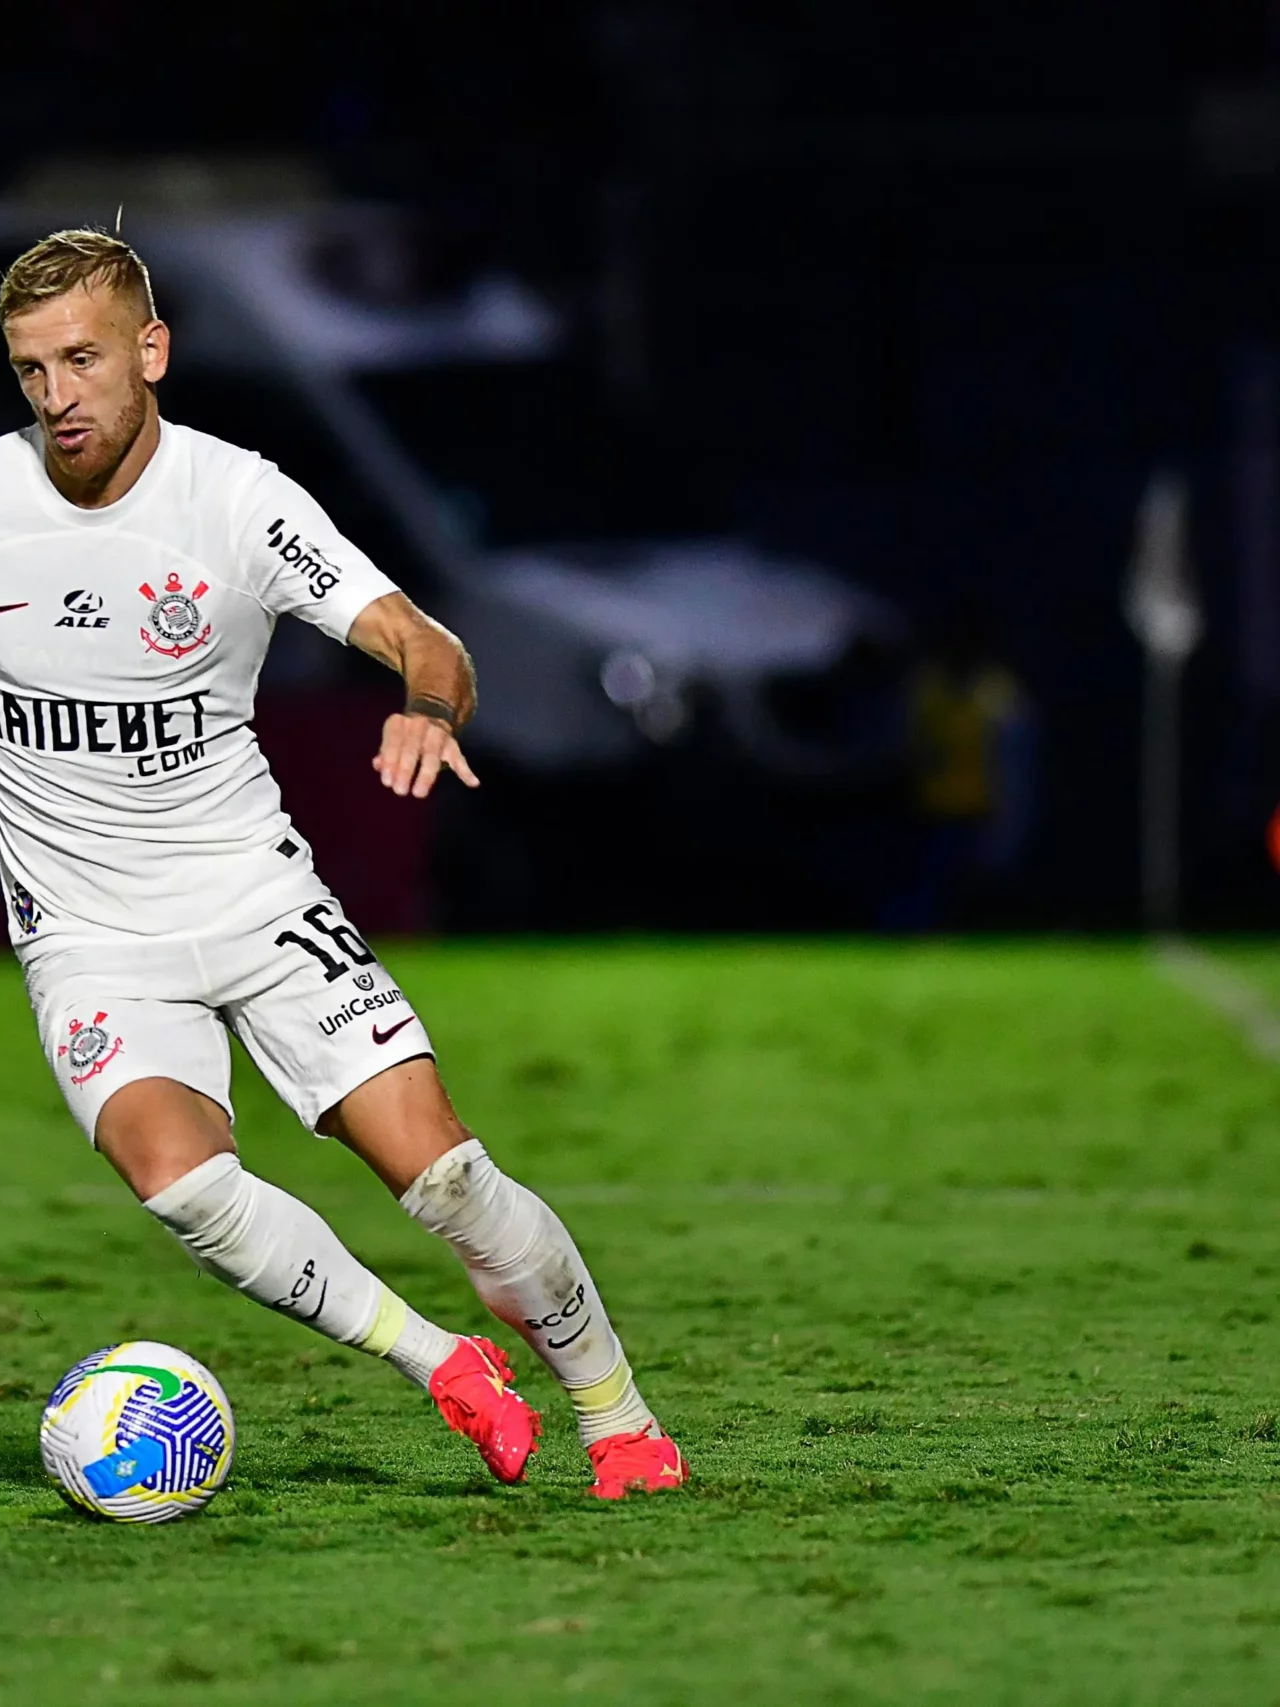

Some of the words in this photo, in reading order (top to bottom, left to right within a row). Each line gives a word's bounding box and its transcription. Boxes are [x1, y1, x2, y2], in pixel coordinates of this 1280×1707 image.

[279, 533, 340, 600] bmg
[54, 616, 111, 629] ALE
[127, 740, 206, 779] .COM
[274, 903, 377, 984] 16
[524, 1283, 585, 1330] SCCP
